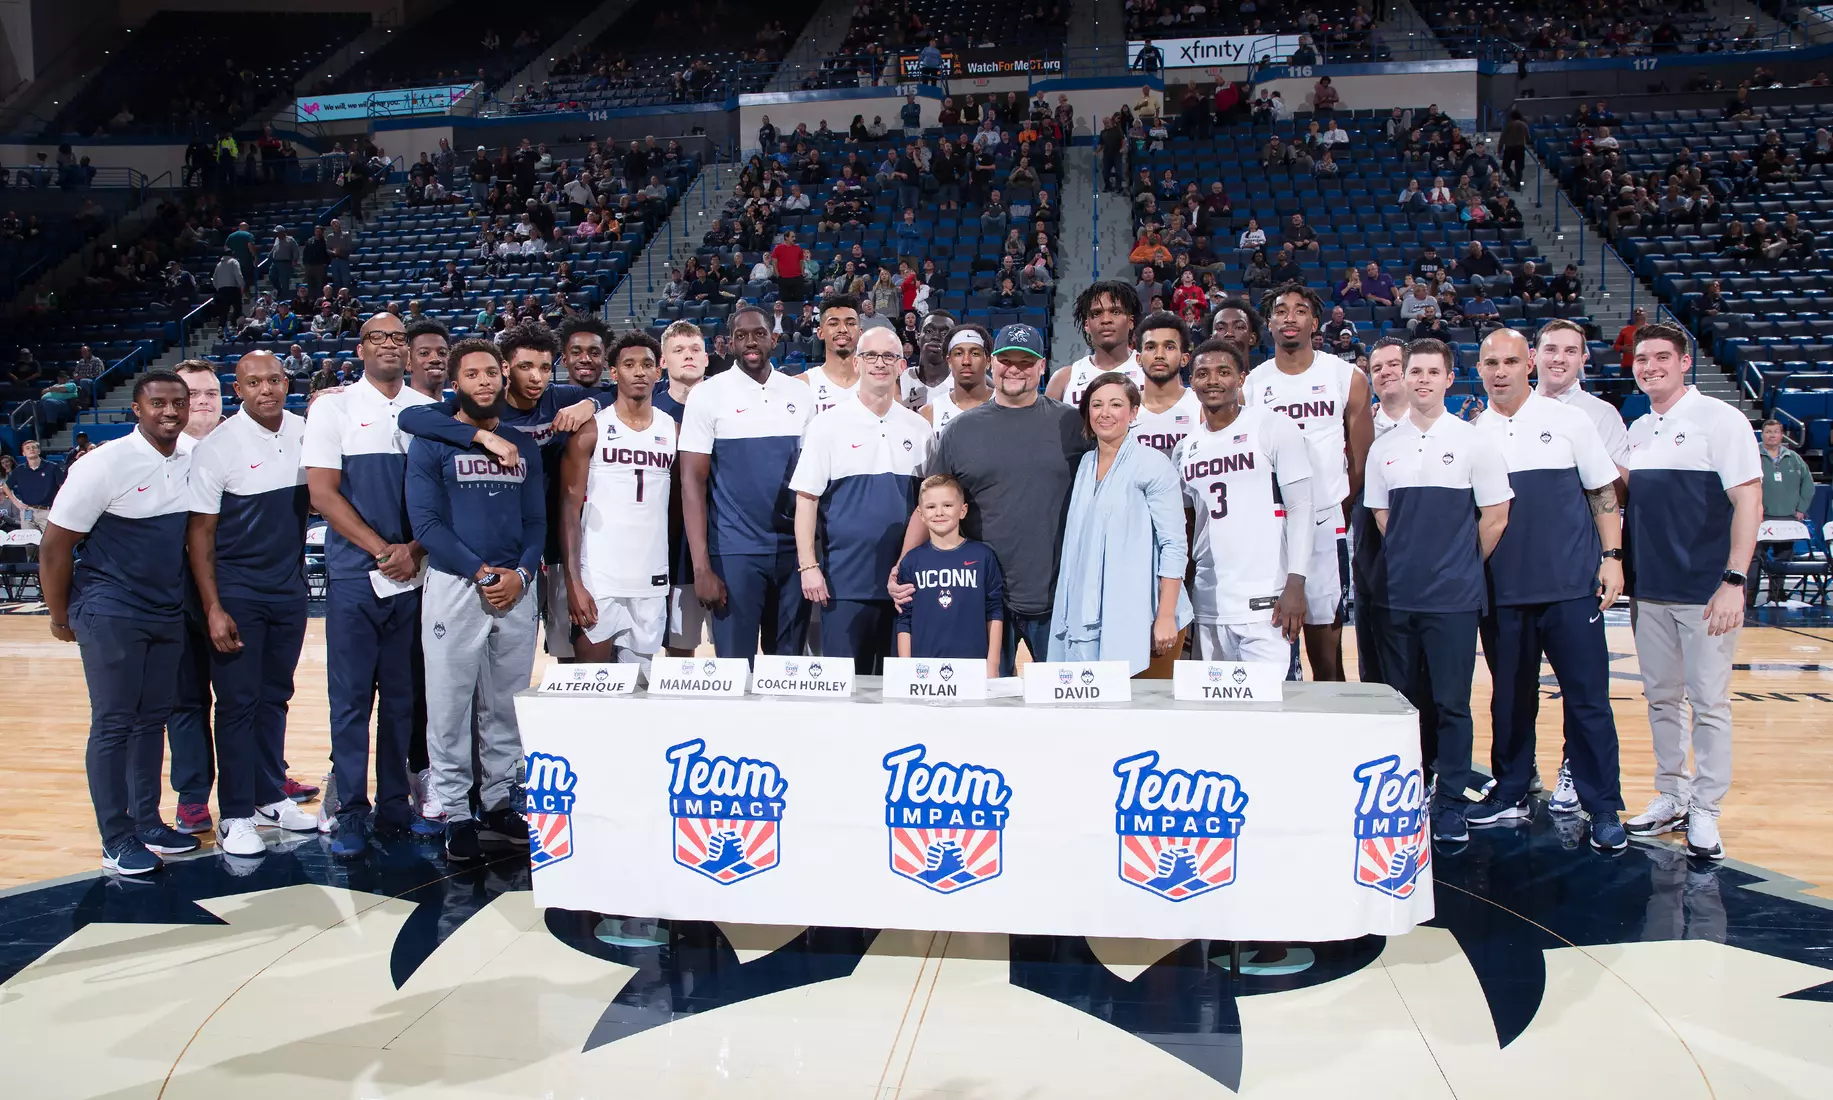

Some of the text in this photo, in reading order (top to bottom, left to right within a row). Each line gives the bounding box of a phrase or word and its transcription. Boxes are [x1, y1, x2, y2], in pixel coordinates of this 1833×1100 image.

[1180, 40, 1244, 63] xfinity
[905, 59, 951, 70] WAH
[967, 60, 1061, 74] WatchForMeCT.org
[1288, 66, 1313, 77] 116
[1633, 58, 1658, 70] 117
[895, 85, 918, 95] 115
[588, 110, 608, 121] 114
[602, 448, 674, 470] UCONN
[1184, 452, 1255, 482] UCONN
[634, 469, 645, 503] 1
[1210, 482, 1228, 520] 3
[915, 568, 978, 589] UCONN
[546, 682, 626, 693] ALTERIQUE
[660, 679, 733, 692] MAMADOU
[757, 679, 847, 692] COACH HURLEY
[909, 683, 957, 697] RYLAN
[1054, 686, 1100, 699] DAVID
[1201, 686, 1254, 699] TANYA
[668, 741, 786, 799] Team
[886, 749, 1009, 806] Team
[1117, 755, 1245, 814] Team
[1358, 759, 1421, 816] Tea
[526, 794, 572, 812] ACT
[672, 798, 783, 818] IMPACT
[888, 806, 1006, 828] IMPACT
[1119, 813, 1242, 835] IMPACT
